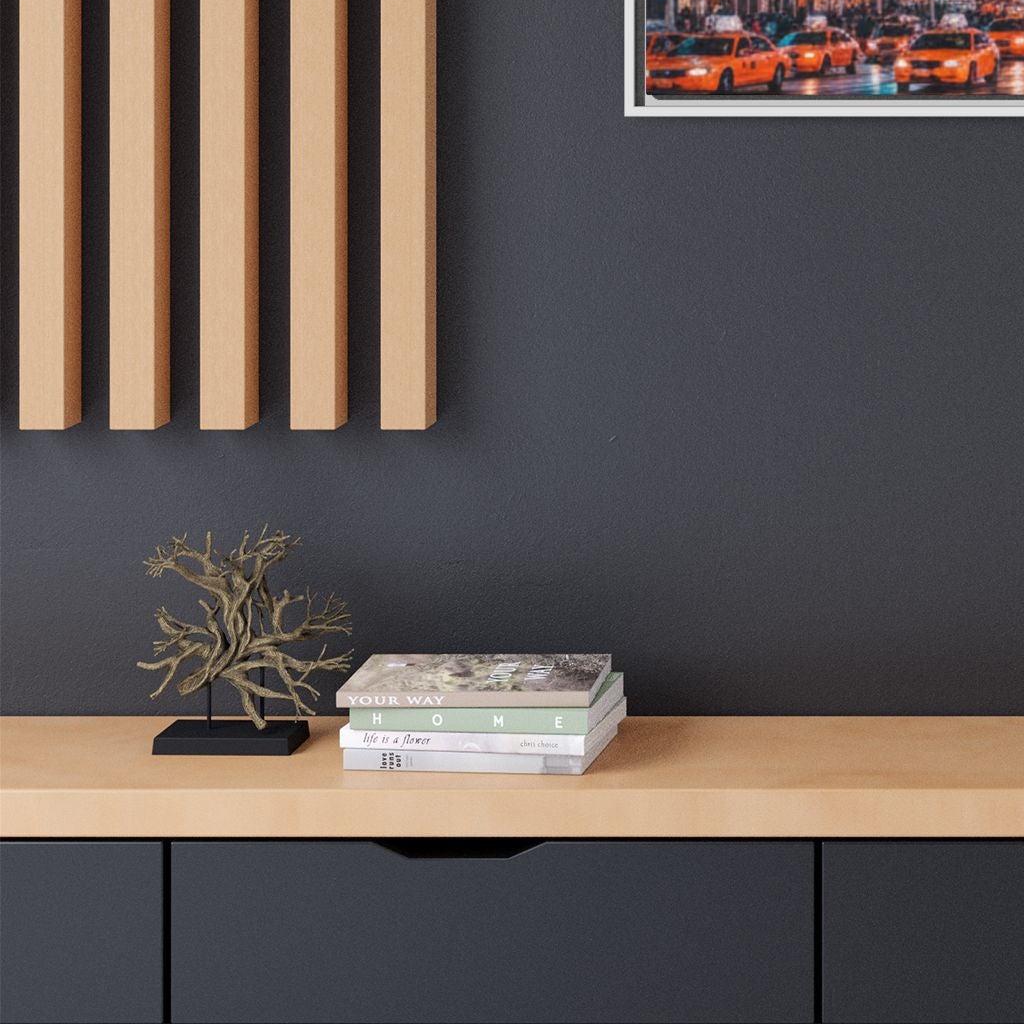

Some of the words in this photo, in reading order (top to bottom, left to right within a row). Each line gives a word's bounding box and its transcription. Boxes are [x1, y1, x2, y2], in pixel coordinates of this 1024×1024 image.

[348, 695, 400, 705] YOUR
[406, 695, 446, 705] WAY
[372, 712, 564, 729] HOME
[363, 732, 379, 747] life
[381, 734, 390, 744] is
[393, 736, 400, 744] a
[400, 733, 432, 748] flower
[380, 752, 388, 769] love
